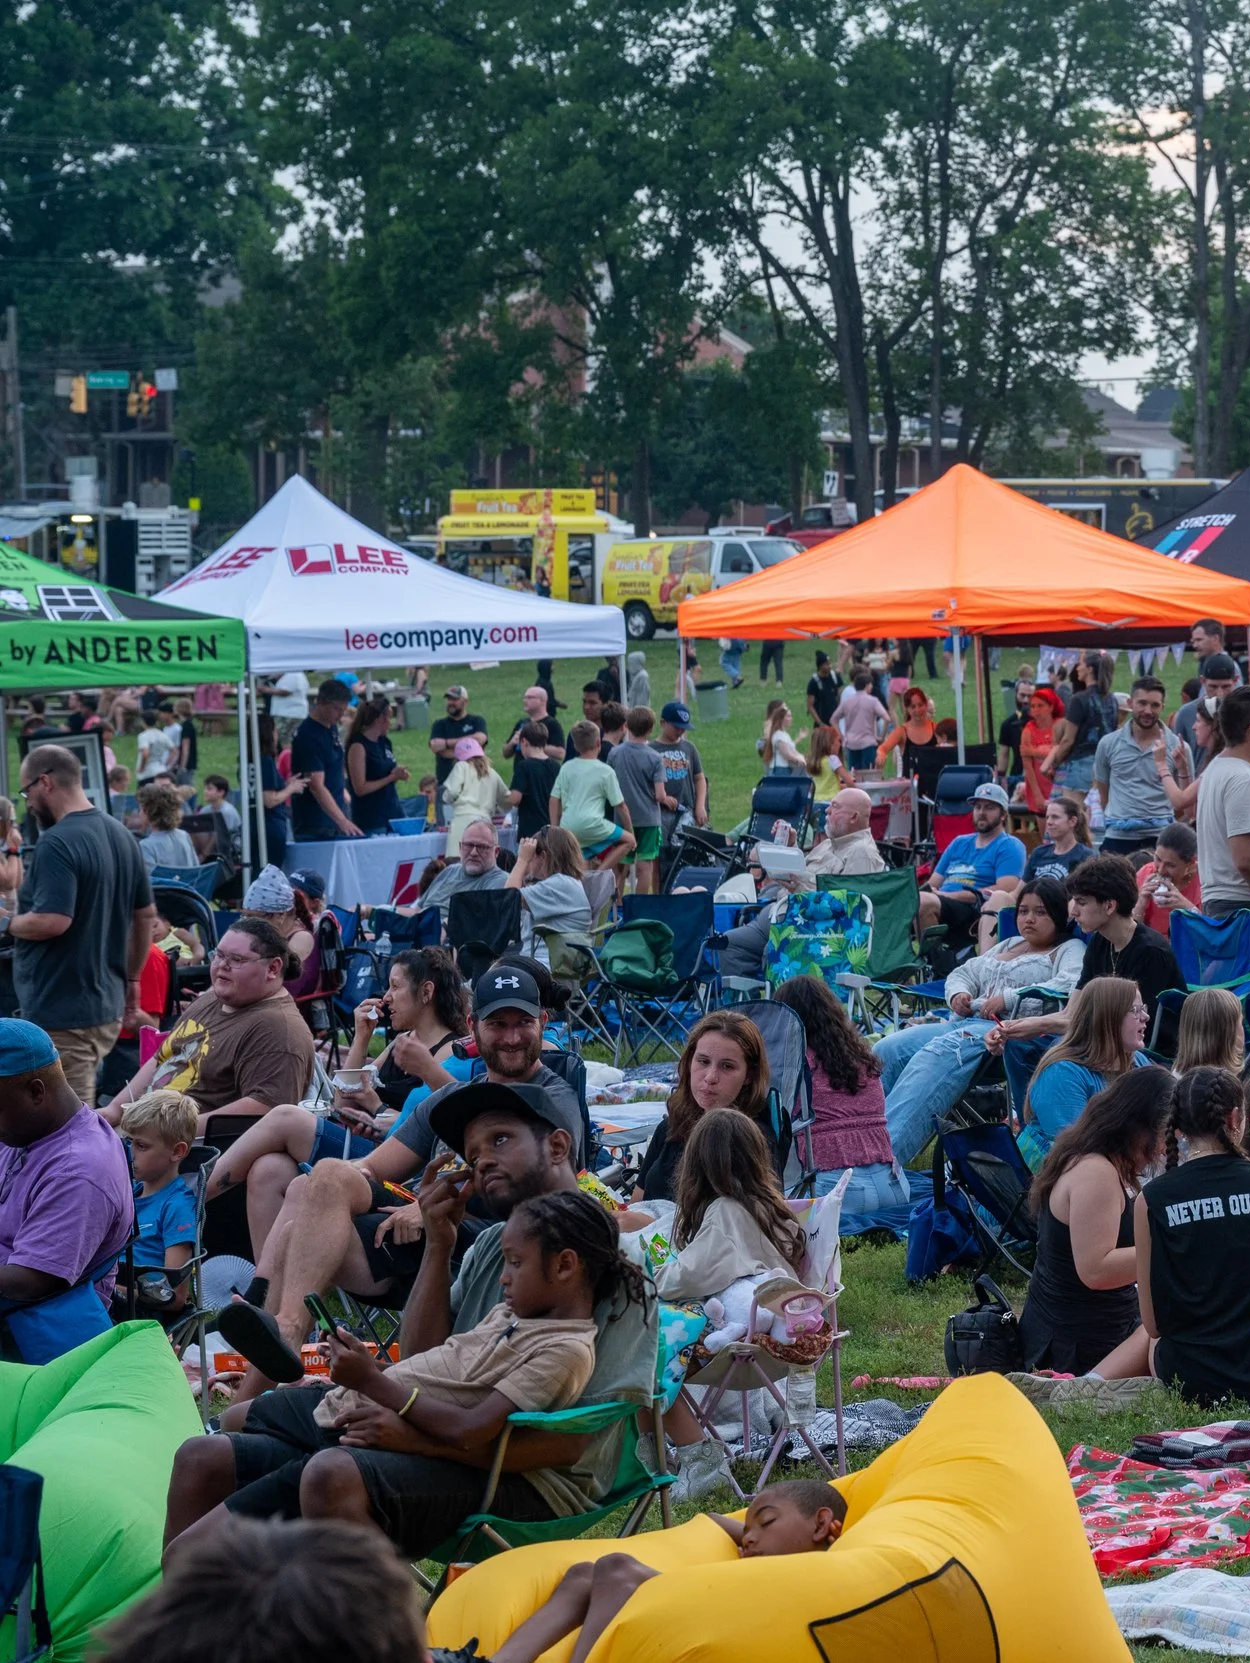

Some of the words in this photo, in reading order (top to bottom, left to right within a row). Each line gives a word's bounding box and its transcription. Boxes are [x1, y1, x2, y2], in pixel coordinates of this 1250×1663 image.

[476, 501, 499, 513] Fruit
[502, 501, 518, 513] Tea
[1175, 514, 1237, 530] STRETCH
[335, 543, 409, 568] LEE
[338, 565, 410, 576] COMPANY
[9, 638, 37, 666] by
[44, 634, 218, 664] ANDERSEN
[345, 625, 538, 651] leecompany.com
[1165, 1196, 1225, 1227] NEVER
